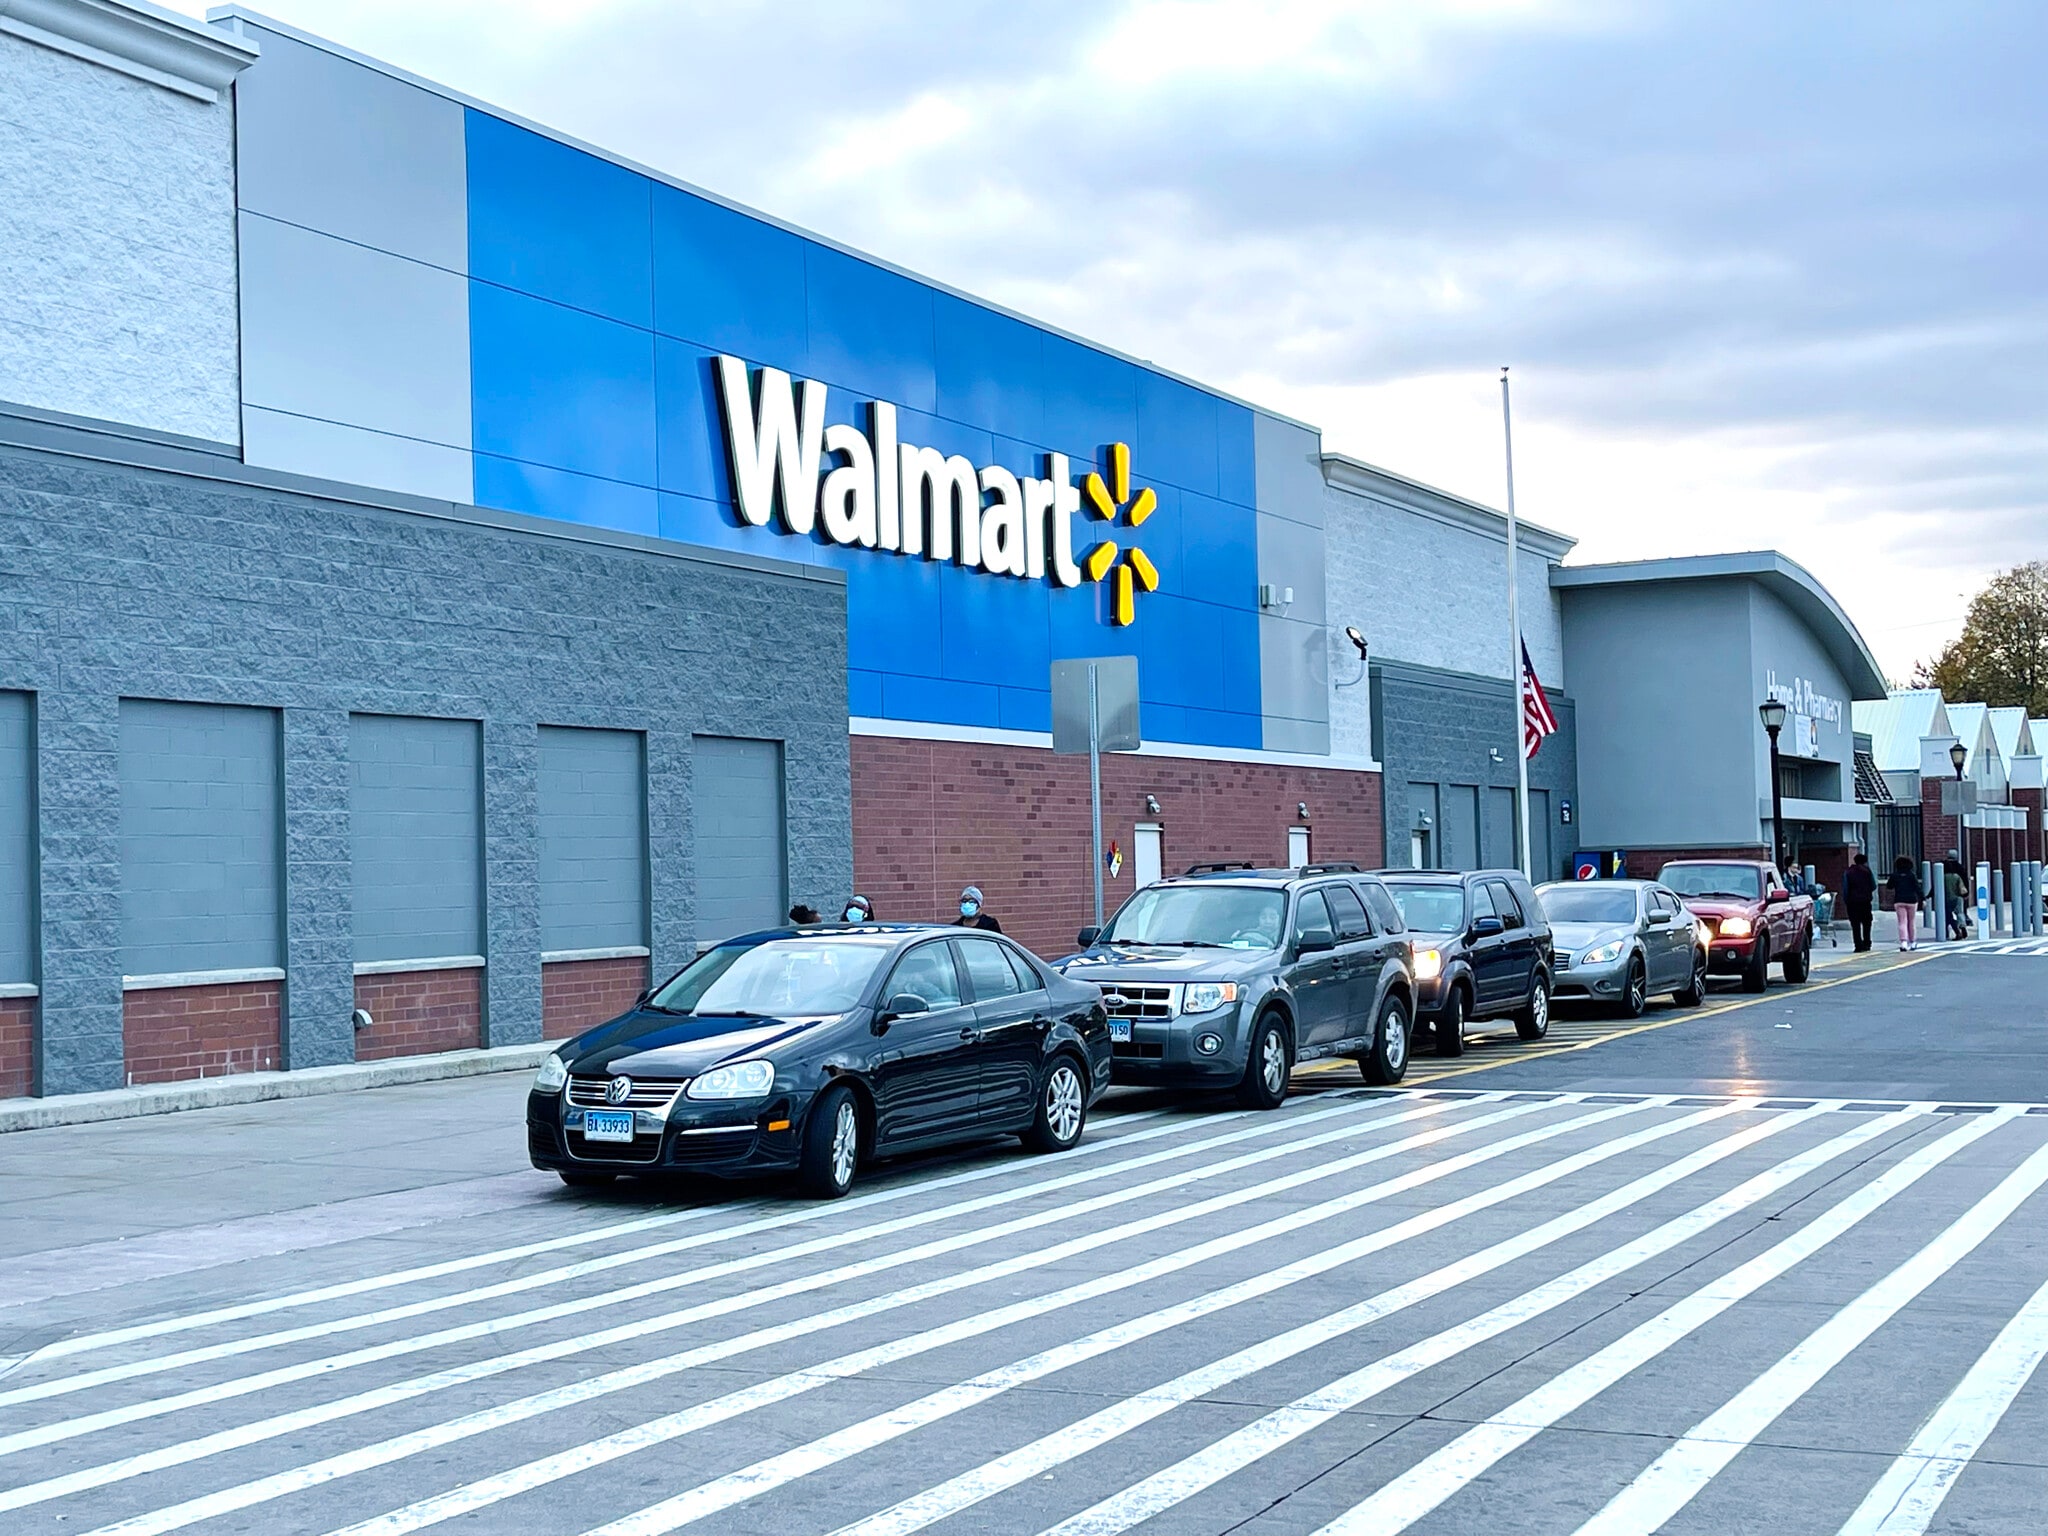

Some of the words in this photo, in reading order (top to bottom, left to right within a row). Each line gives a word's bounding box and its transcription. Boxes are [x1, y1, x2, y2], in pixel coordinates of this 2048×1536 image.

[716, 354, 1082, 589] Walmart
[1766, 668, 1794, 714] Home
[1794, 676, 1803, 714] &
[1803, 679, 1843, 735] Pharmacy
